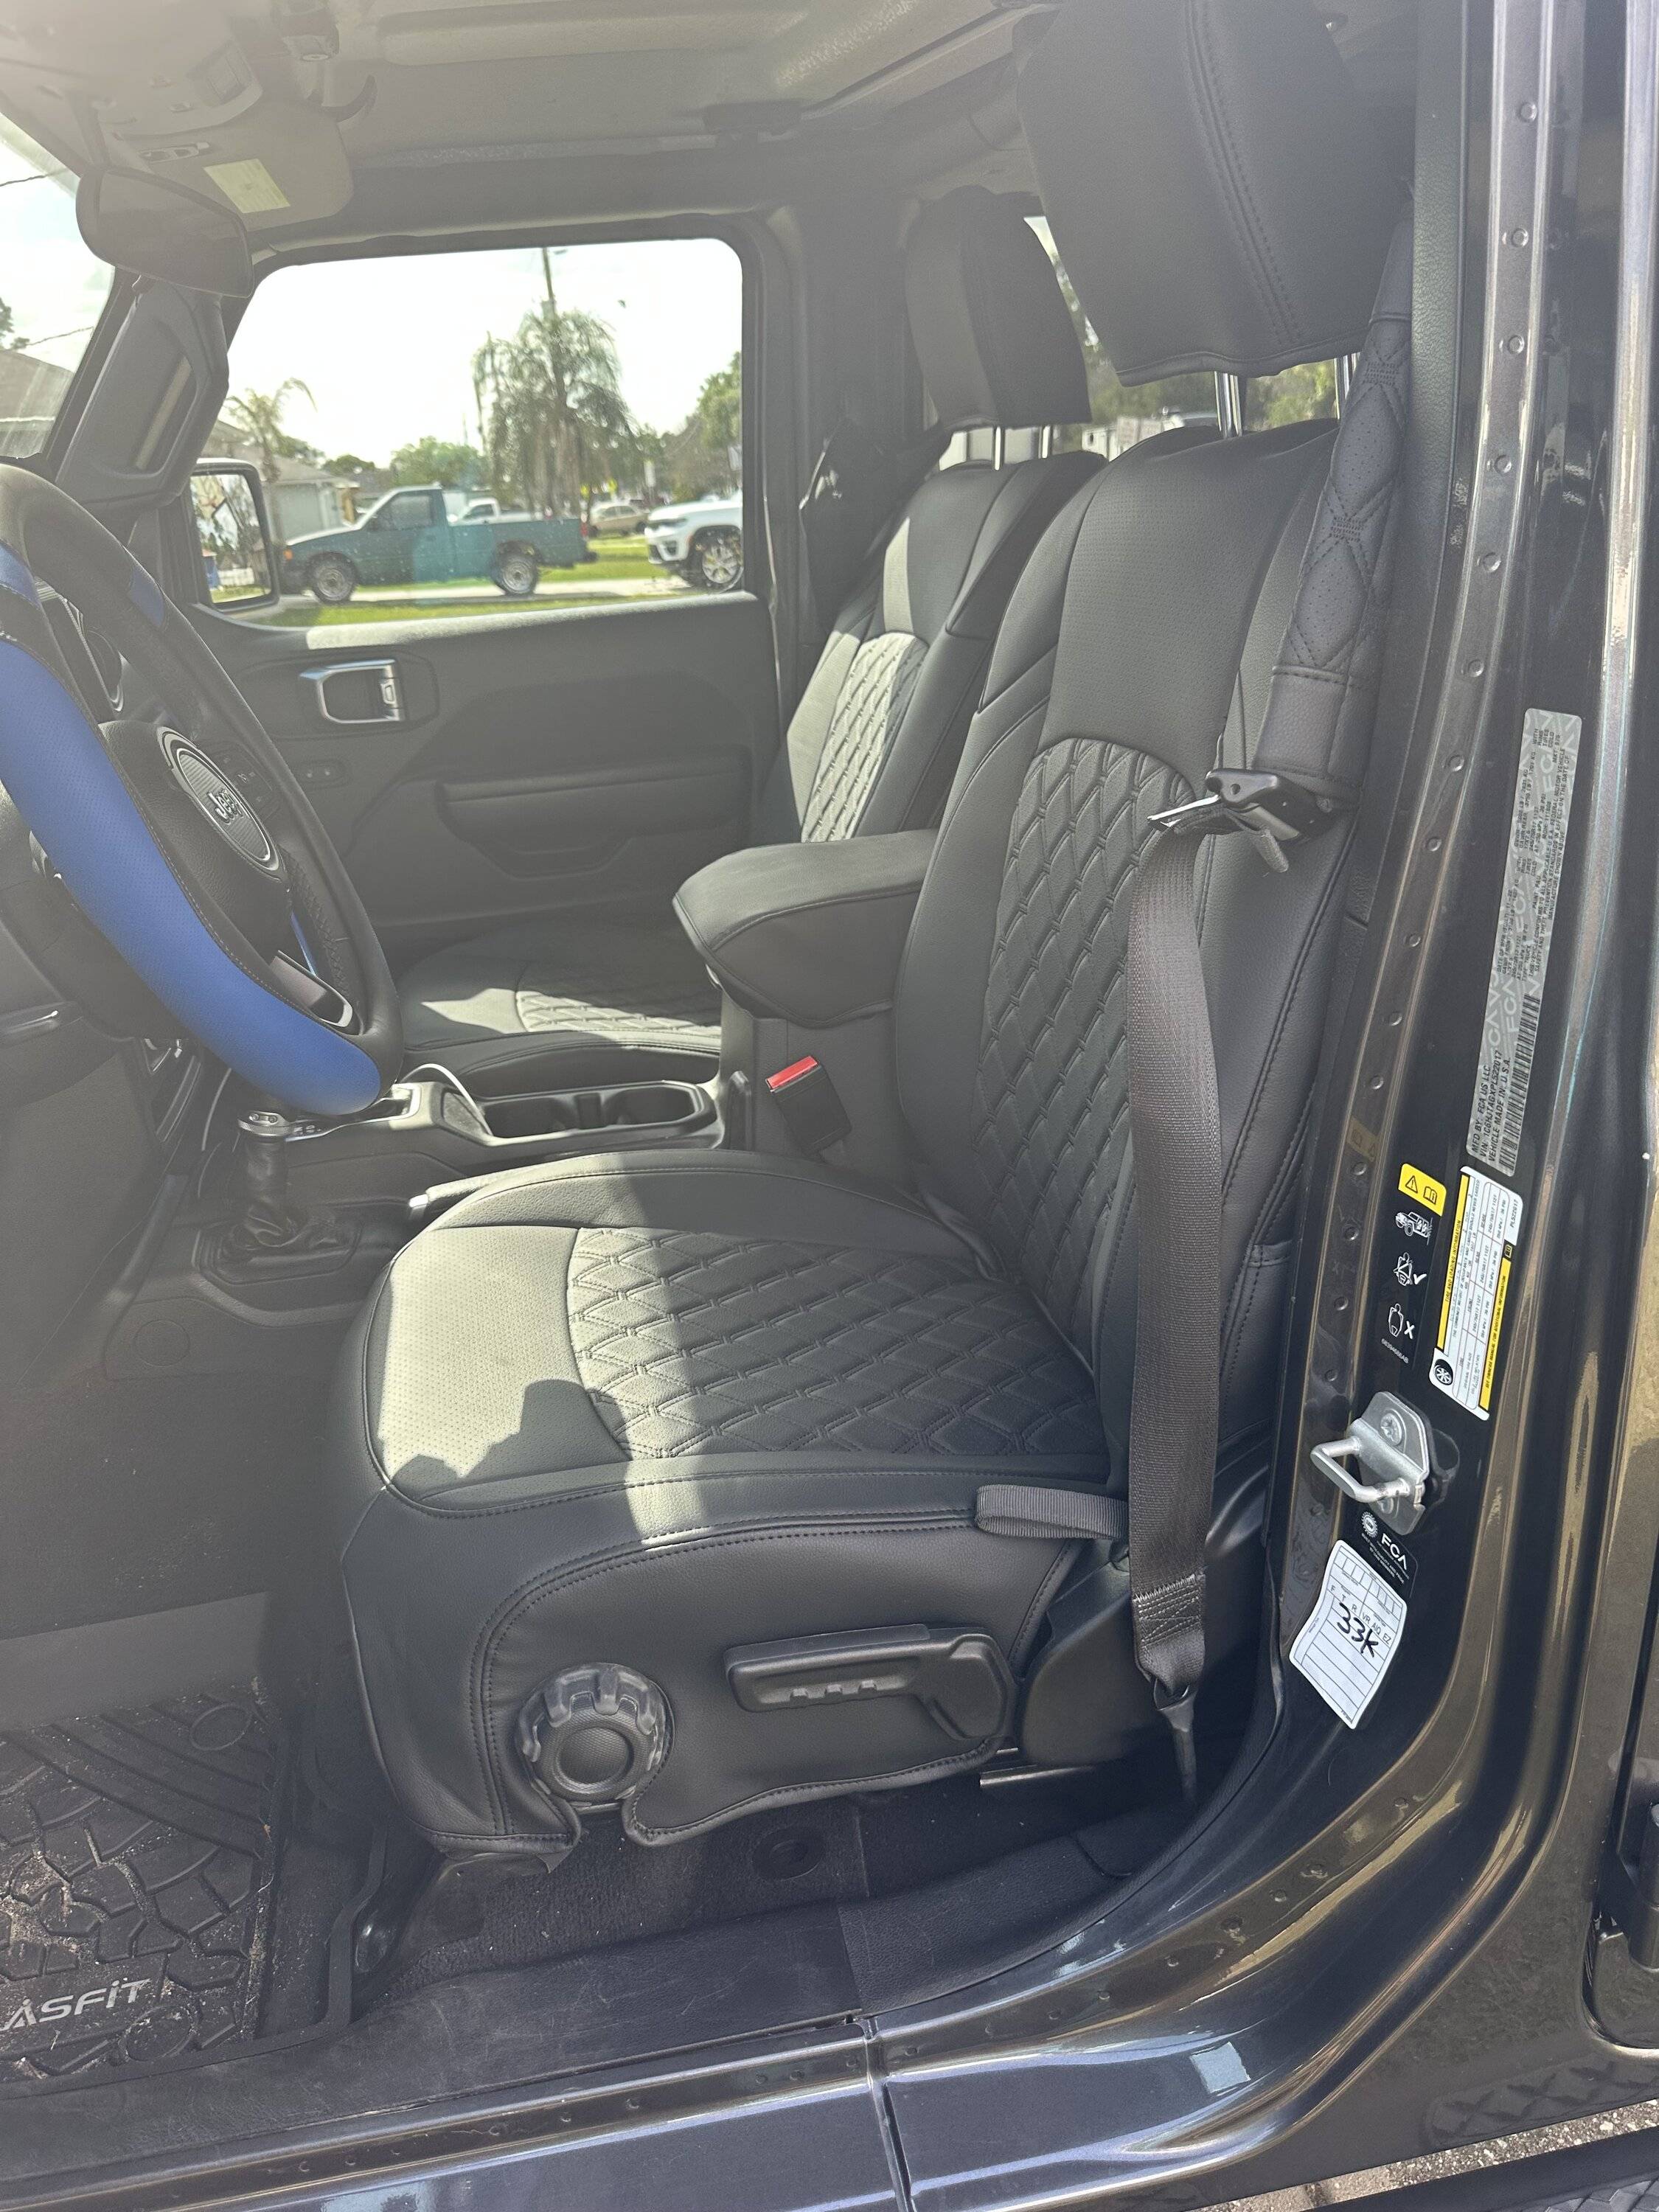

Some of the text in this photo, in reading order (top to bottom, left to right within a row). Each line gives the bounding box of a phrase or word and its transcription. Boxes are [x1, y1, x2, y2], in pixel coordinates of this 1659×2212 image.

[206, 788, 243, 824] Jeep
[1481, 1063, 1490, 1081] LLC
[1479, 1082, 1487, 1096] US
[1476, 1096, 1486, 1114] FCA
[1493, 1099, 1504, 1125] MADE
[1471, 1133, 1481, 1153] MFD
[1488, 1126, 1500, 1163] VEHICLE
[1381, 1533, 1407, 1571] FCA
[1330, 1585, 1335, 1593] F
[1340, 1593, 1346, 1601] T
[1351, 1603, 1357, 1613] R
[1361, 1612, 1370, 1624] VR
[1382, 1632, 1391, 1644] EZ
